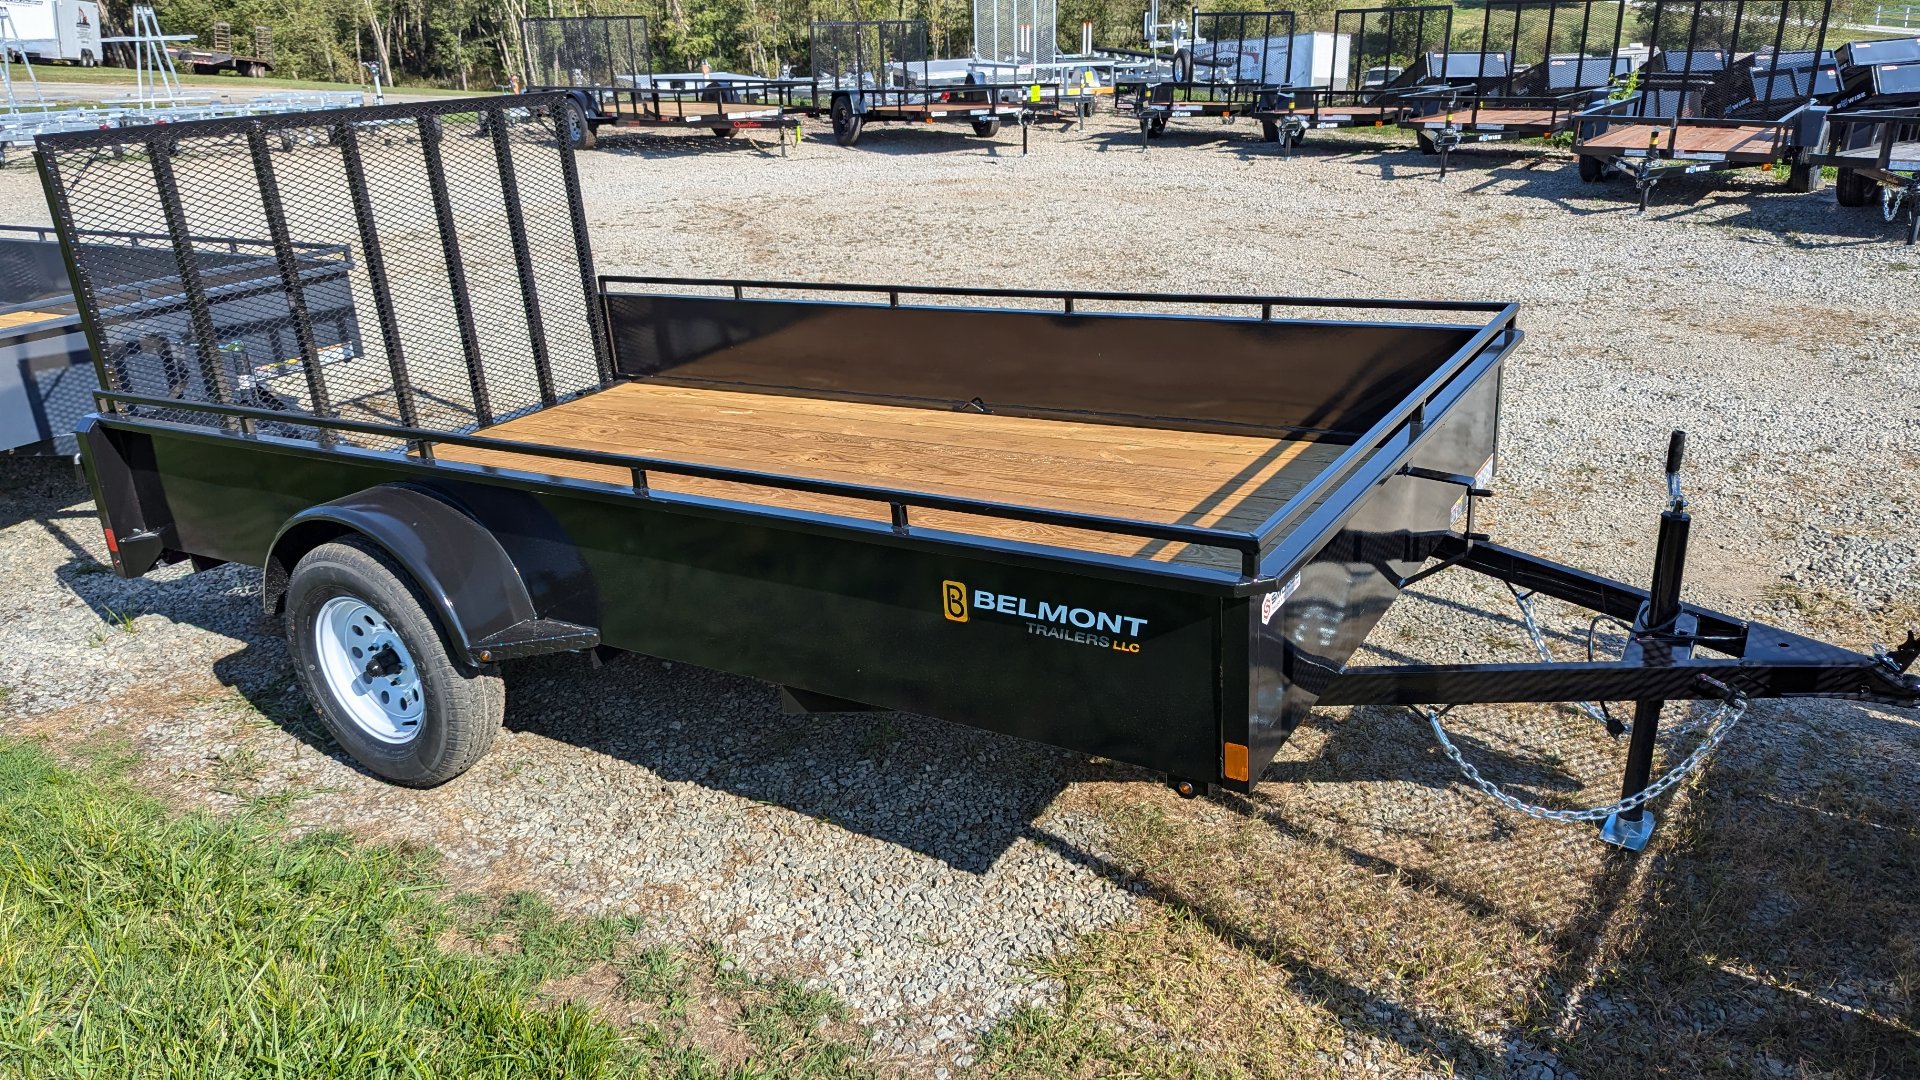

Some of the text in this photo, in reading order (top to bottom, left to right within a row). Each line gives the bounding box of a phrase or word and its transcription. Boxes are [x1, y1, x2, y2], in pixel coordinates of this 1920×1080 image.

[973, 590, 1148, 637] BELMONT
[1025, 621, 1140, 653] TRAILERS LLC
